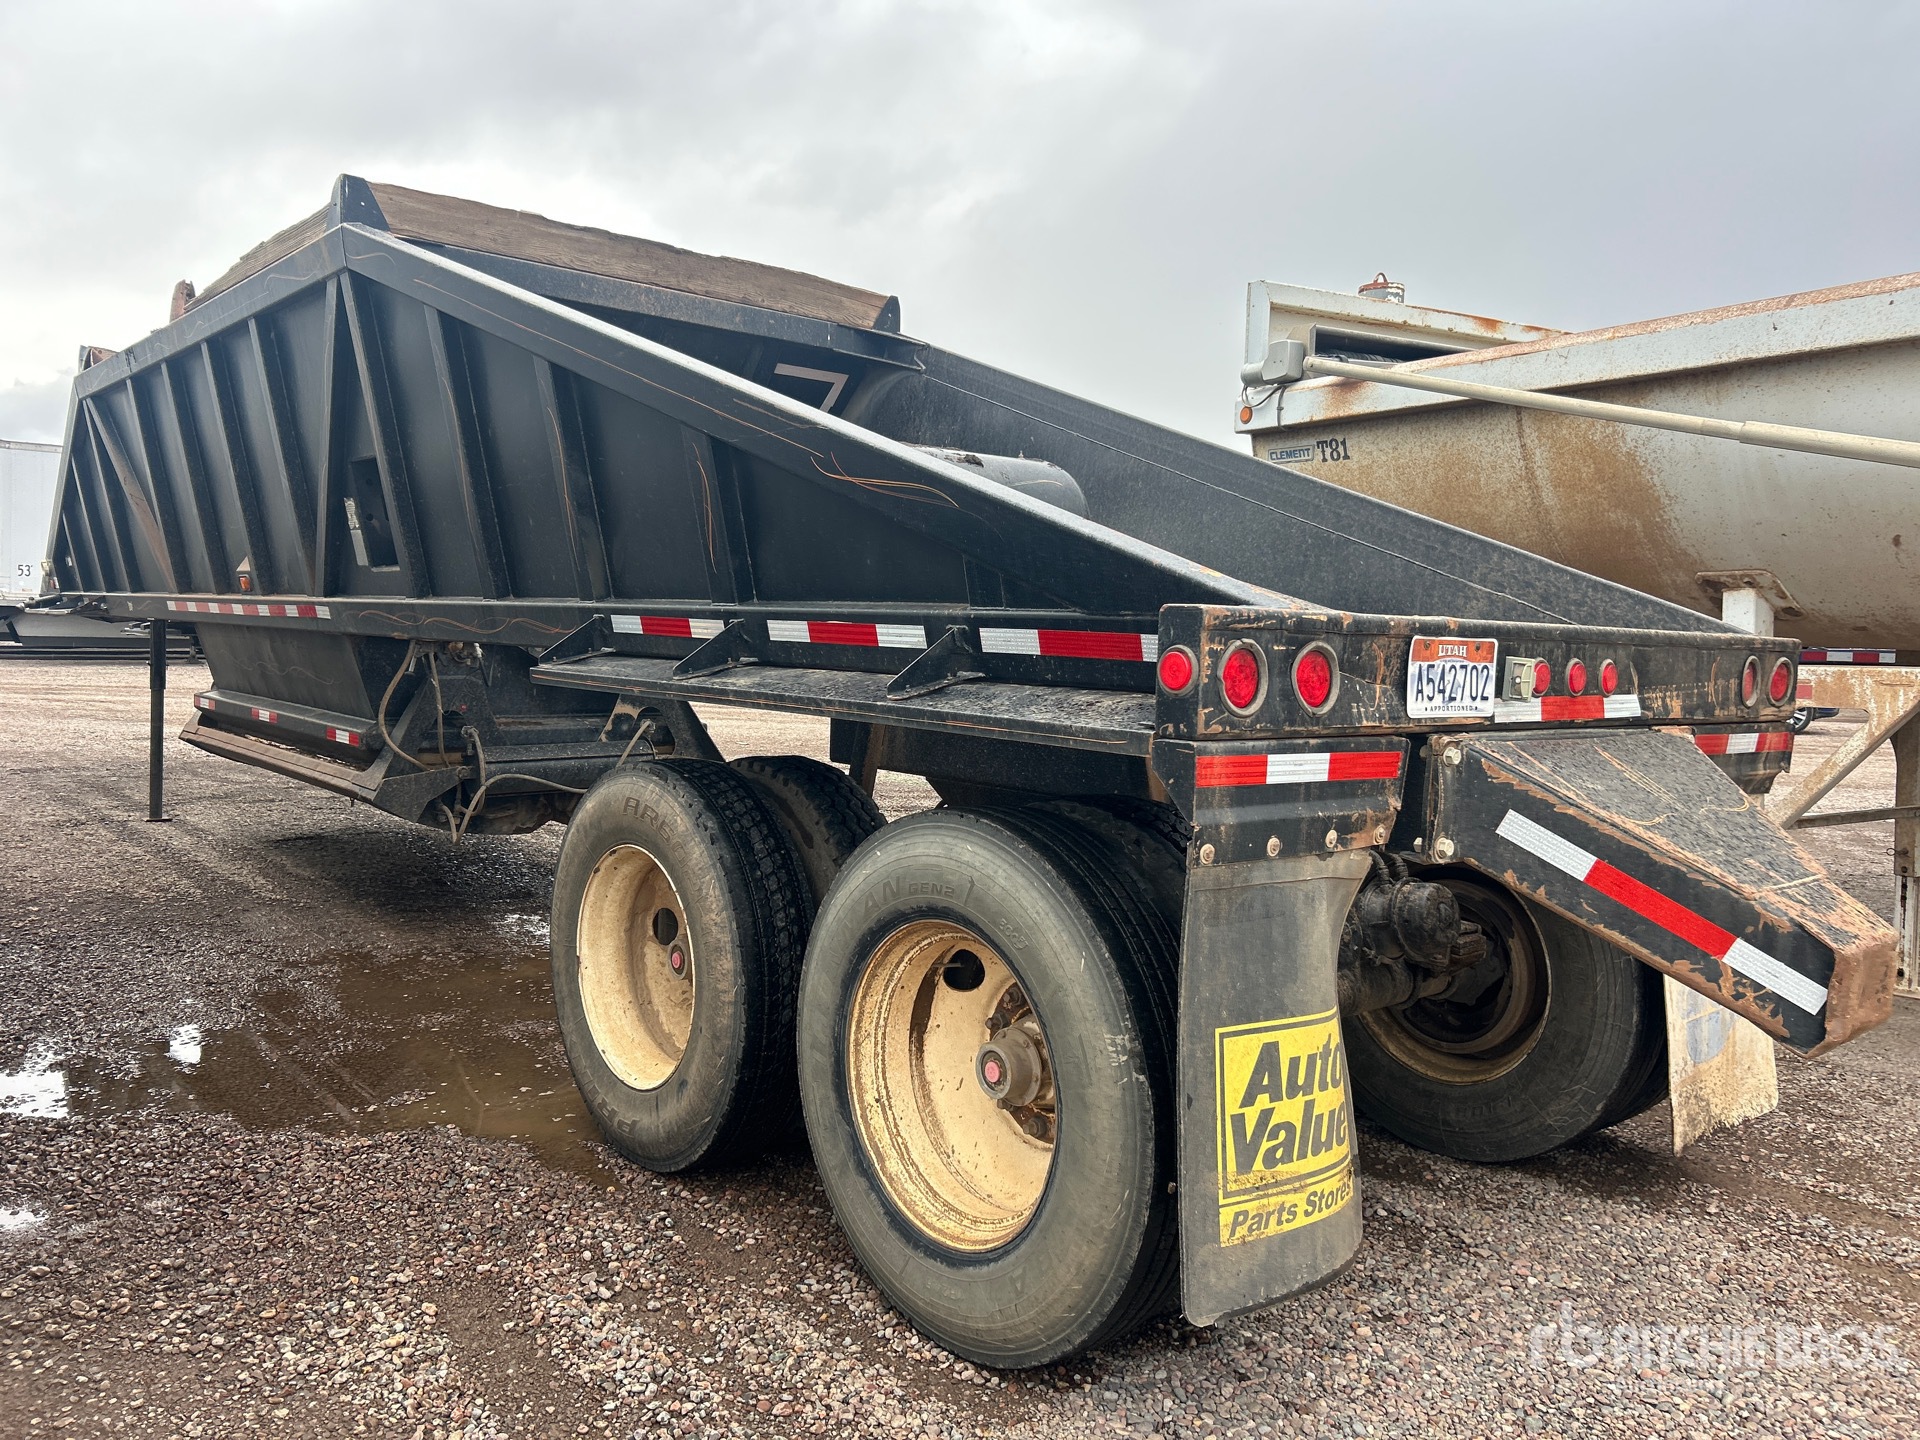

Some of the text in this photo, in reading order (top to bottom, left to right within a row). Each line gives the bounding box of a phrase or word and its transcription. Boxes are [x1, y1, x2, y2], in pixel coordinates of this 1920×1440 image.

[1269, 437, 1350, 463] CLEMENT T81
[1437, 644, 1468, 658] UTAH
[1415, 663, 1490, 702] A542702
[1429, 704, 1474, 712] APPORTIONED
[1238, 1033, 1343, 1109] Auto
[1230, 1098, 1348, 1176] Value
[1228, 1203, 1298, 1239] Parts
